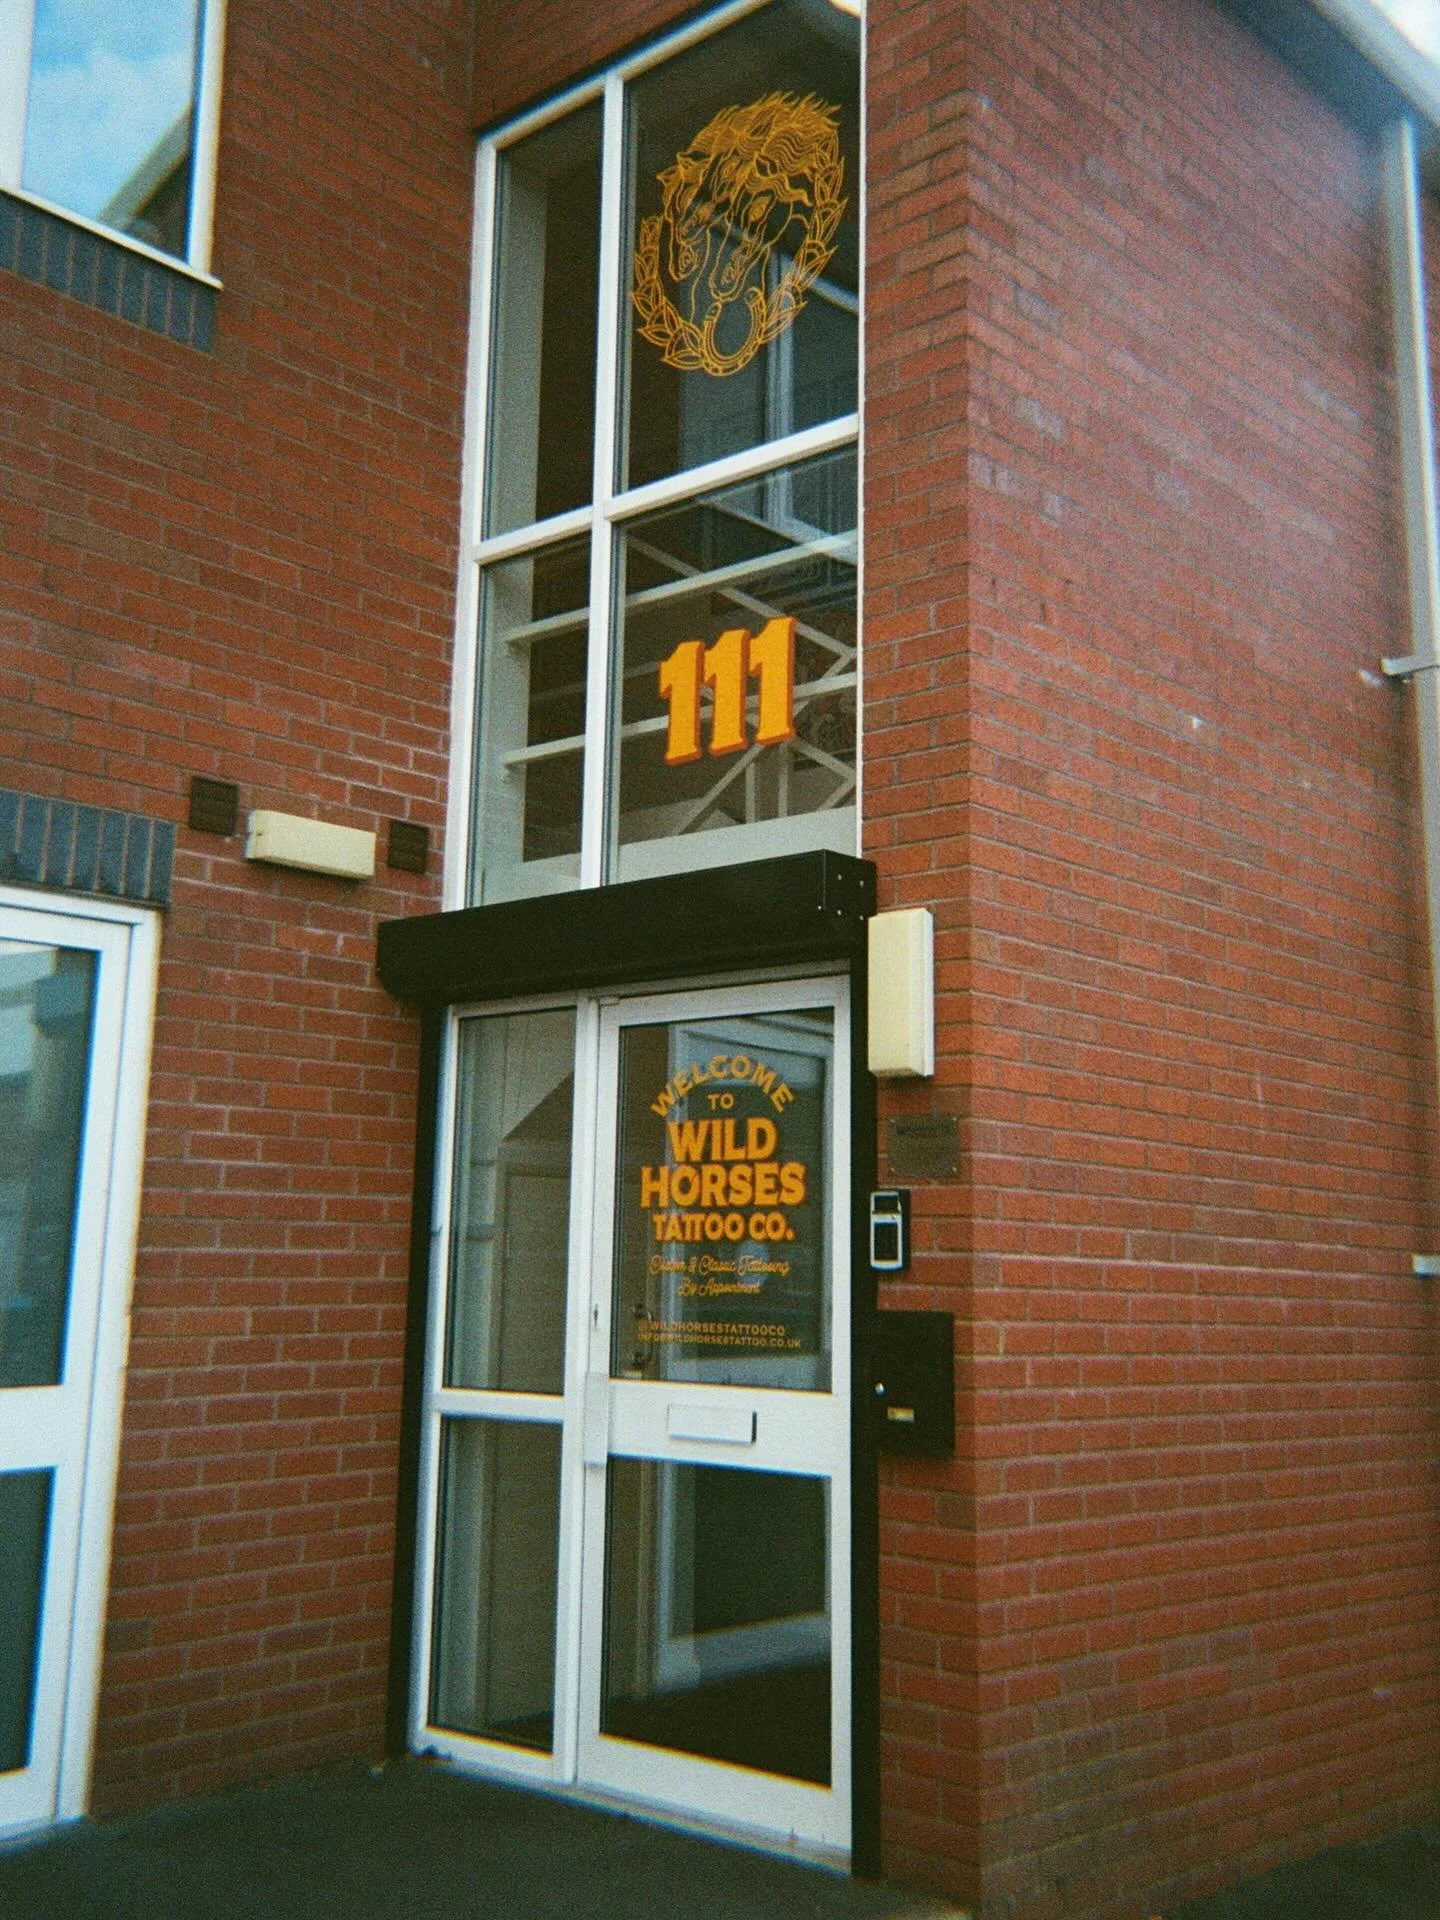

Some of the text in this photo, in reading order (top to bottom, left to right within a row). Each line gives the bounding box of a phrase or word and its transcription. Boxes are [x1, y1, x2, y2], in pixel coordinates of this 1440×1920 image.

[660, 616, 797, 767] 111
[651, 1055, 795, 1118] WELCOME
[708, 1093, 734, 1110] TO
[668, 1117, 778, 1163] WILD
[640, 1161, 807, 1209] HORSES
[653, 1211, 796, 1243] TATTOO CO.
